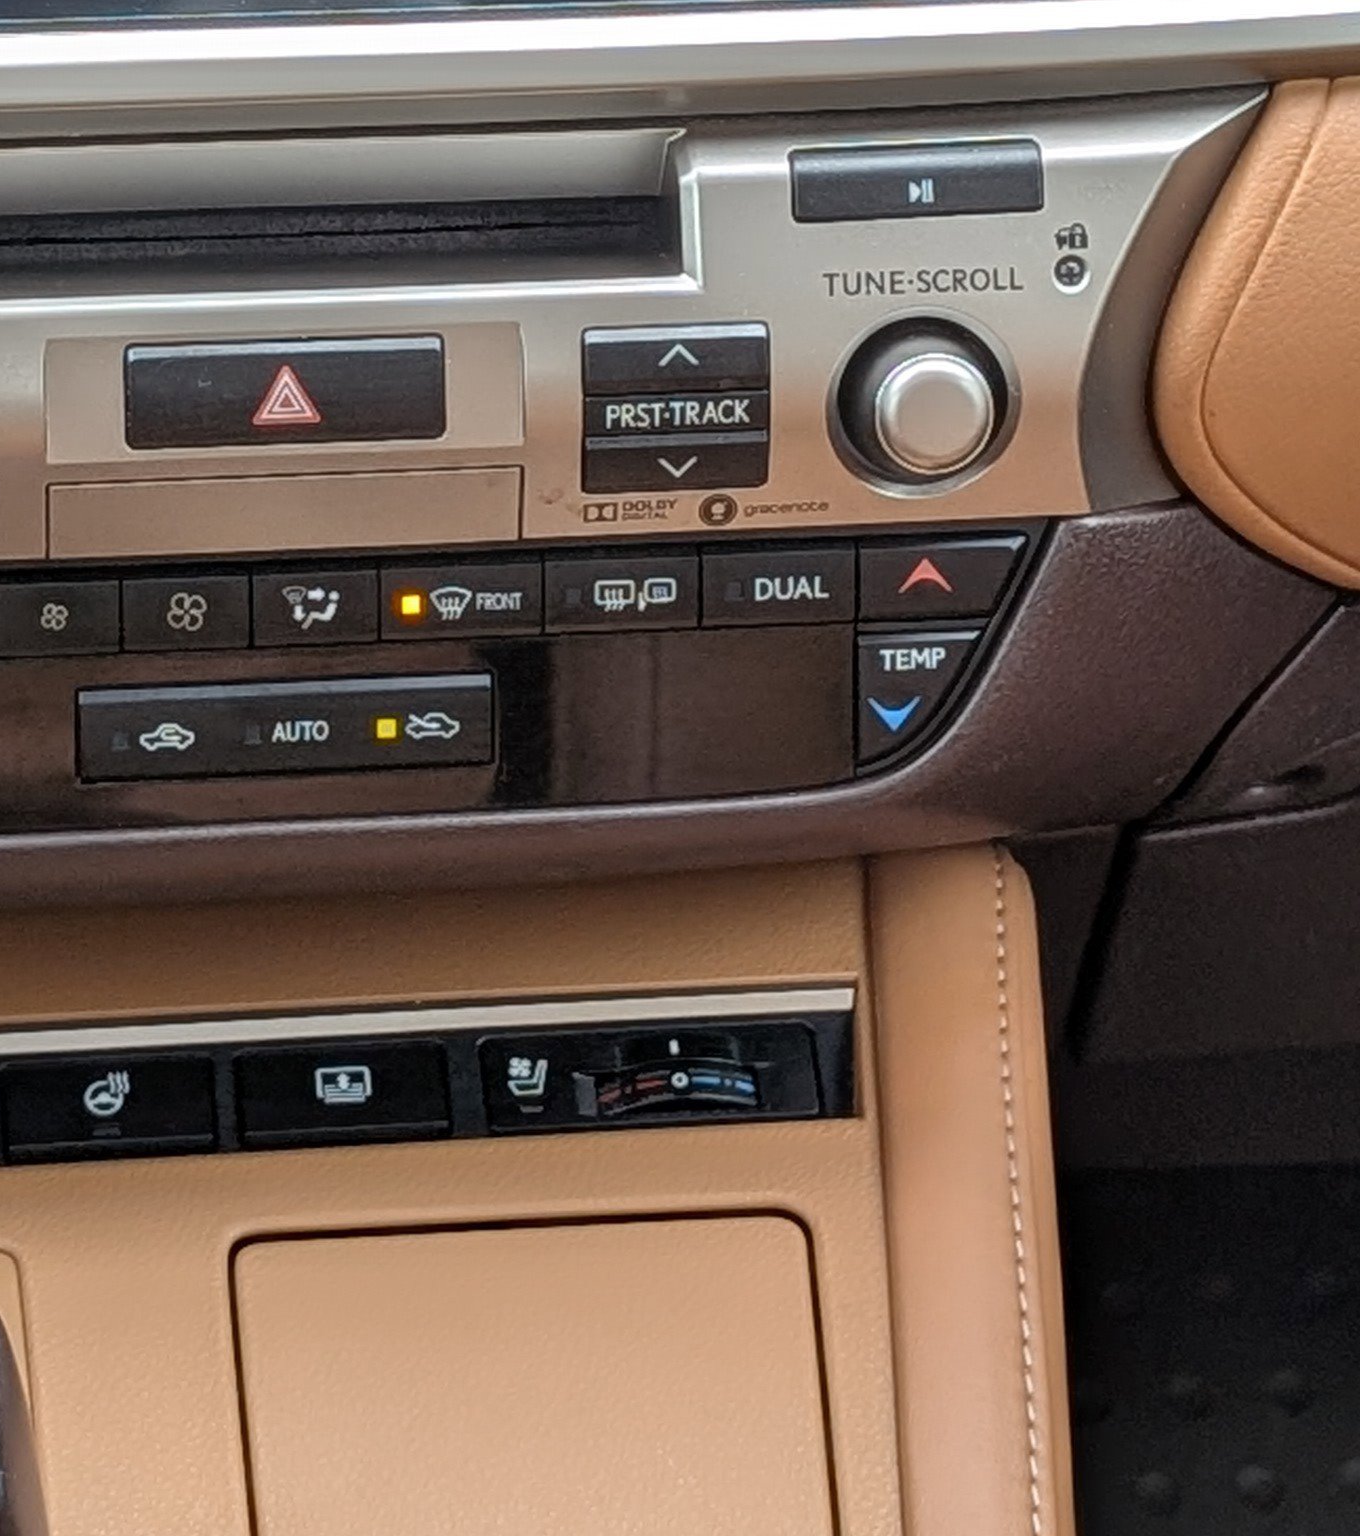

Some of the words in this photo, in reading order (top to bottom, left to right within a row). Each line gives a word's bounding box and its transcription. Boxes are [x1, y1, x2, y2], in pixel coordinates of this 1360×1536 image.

[621, 498, 679, 513] DOLBY
[474, 591, 523, 611] FRONT
[754, 575, 830, 602] DUAL
[878, 646, 947, 672] TEMP
[271, 720, 330, 745] AUTO
